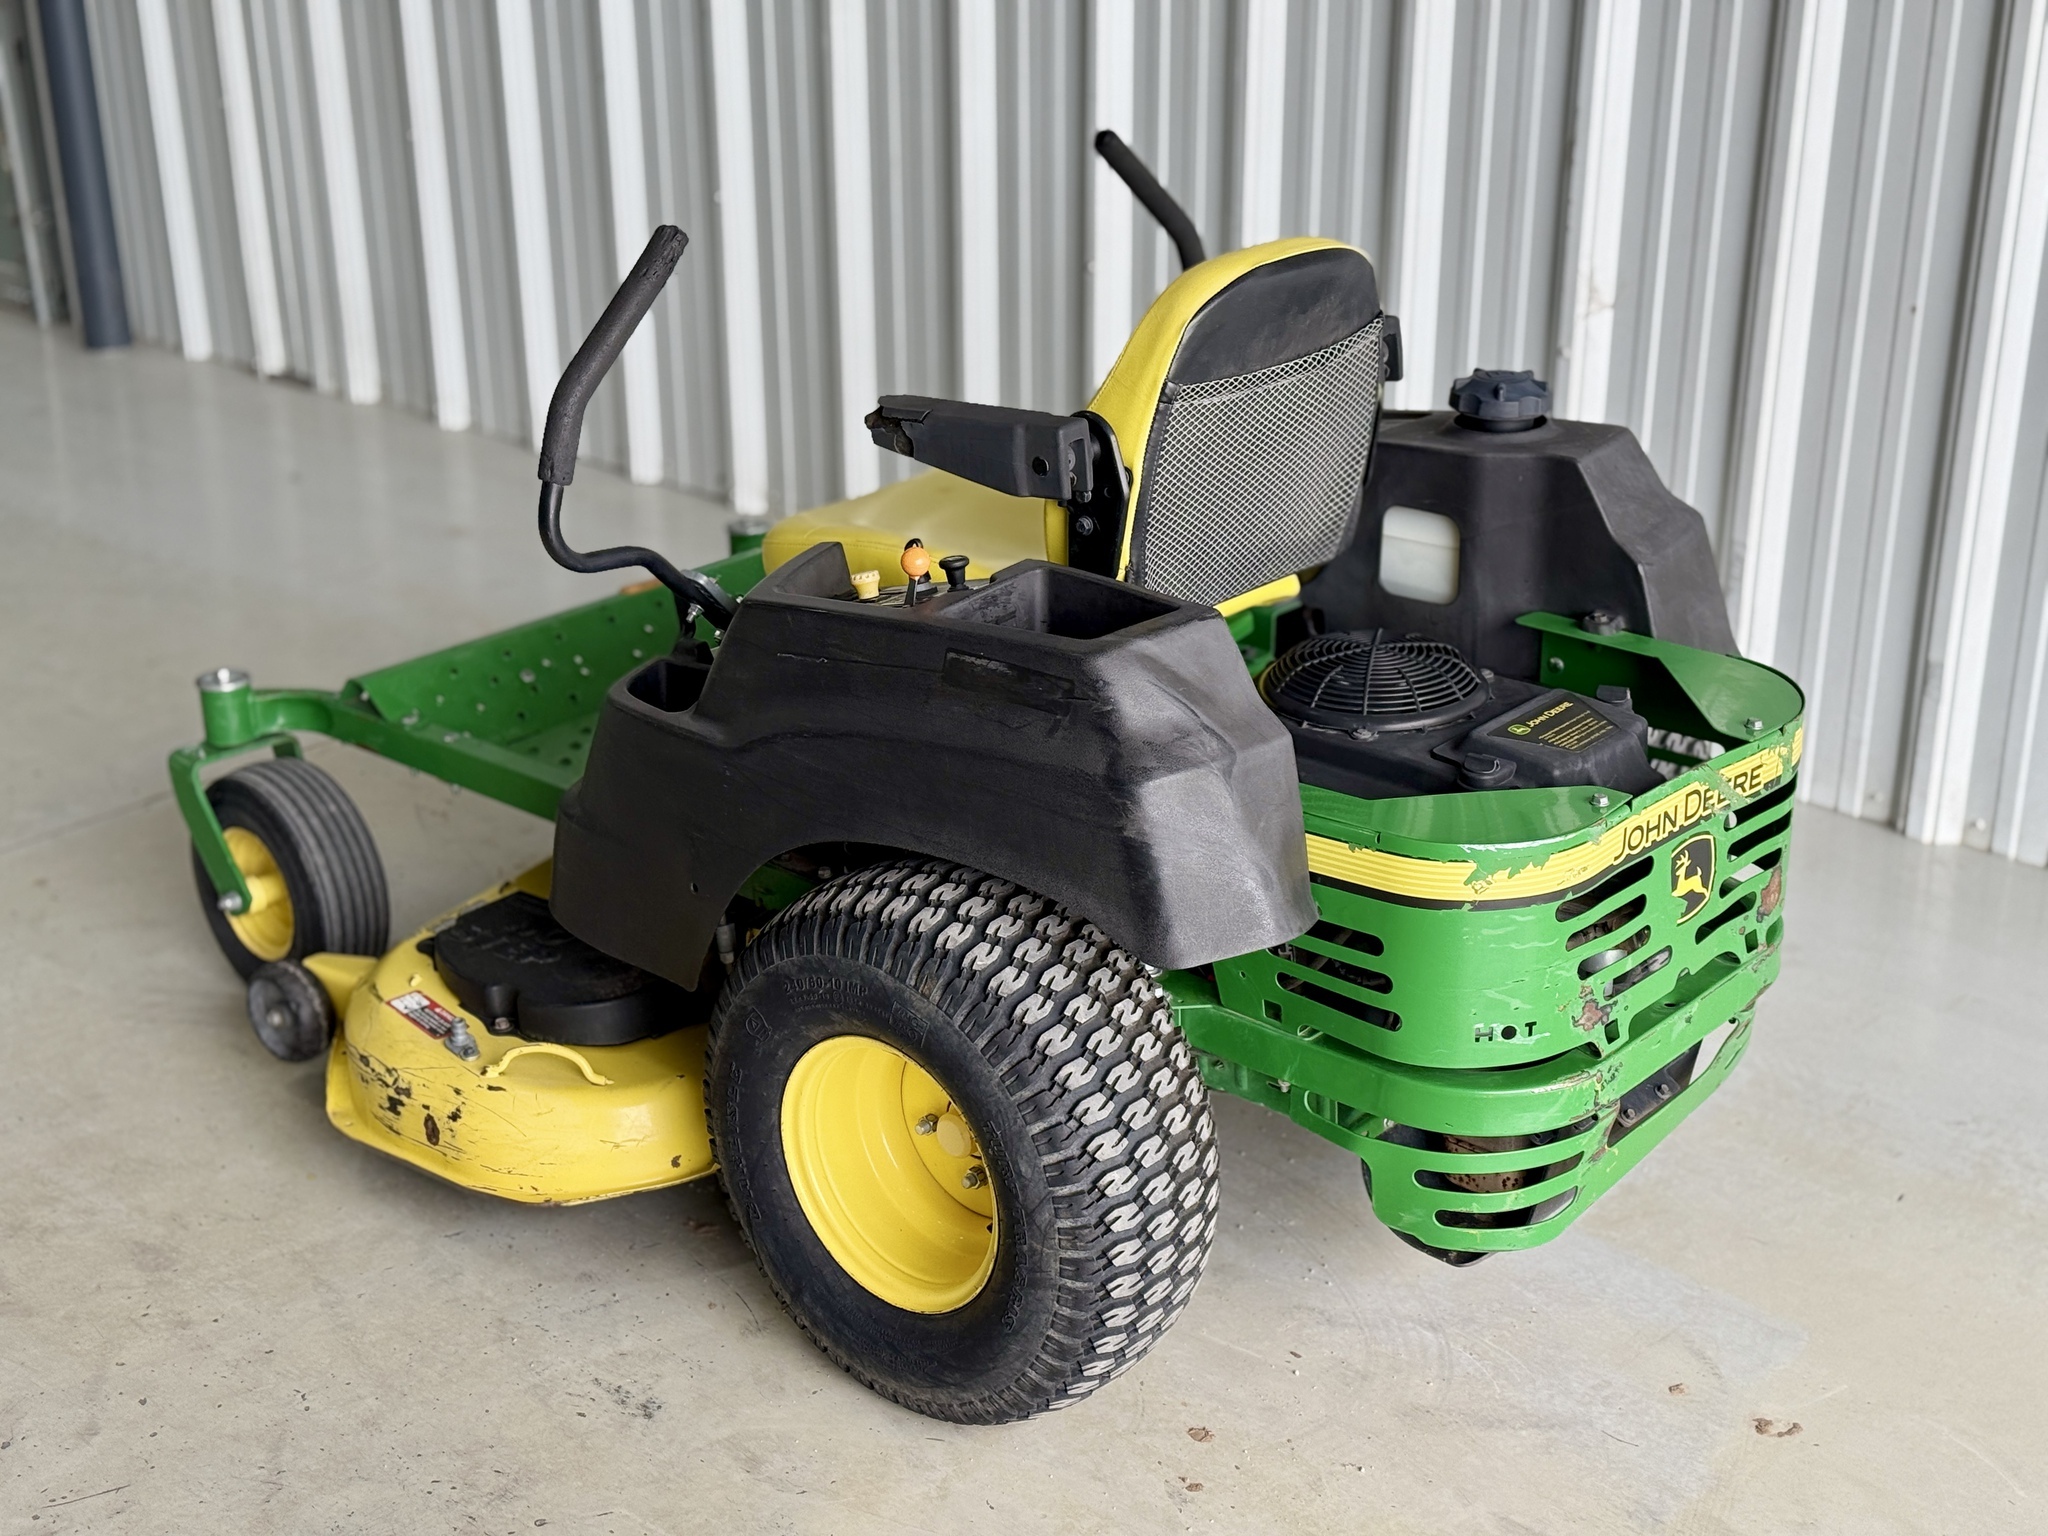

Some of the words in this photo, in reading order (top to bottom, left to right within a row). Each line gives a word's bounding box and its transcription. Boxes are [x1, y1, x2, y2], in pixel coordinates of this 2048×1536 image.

[1526, 713, 1549, 728] JOHN
[1544, 701, 1574, 717] DEERE
[1613, 804, 1679, 862] JOHN
[1474, 1021, 1537, 1042] HOT
